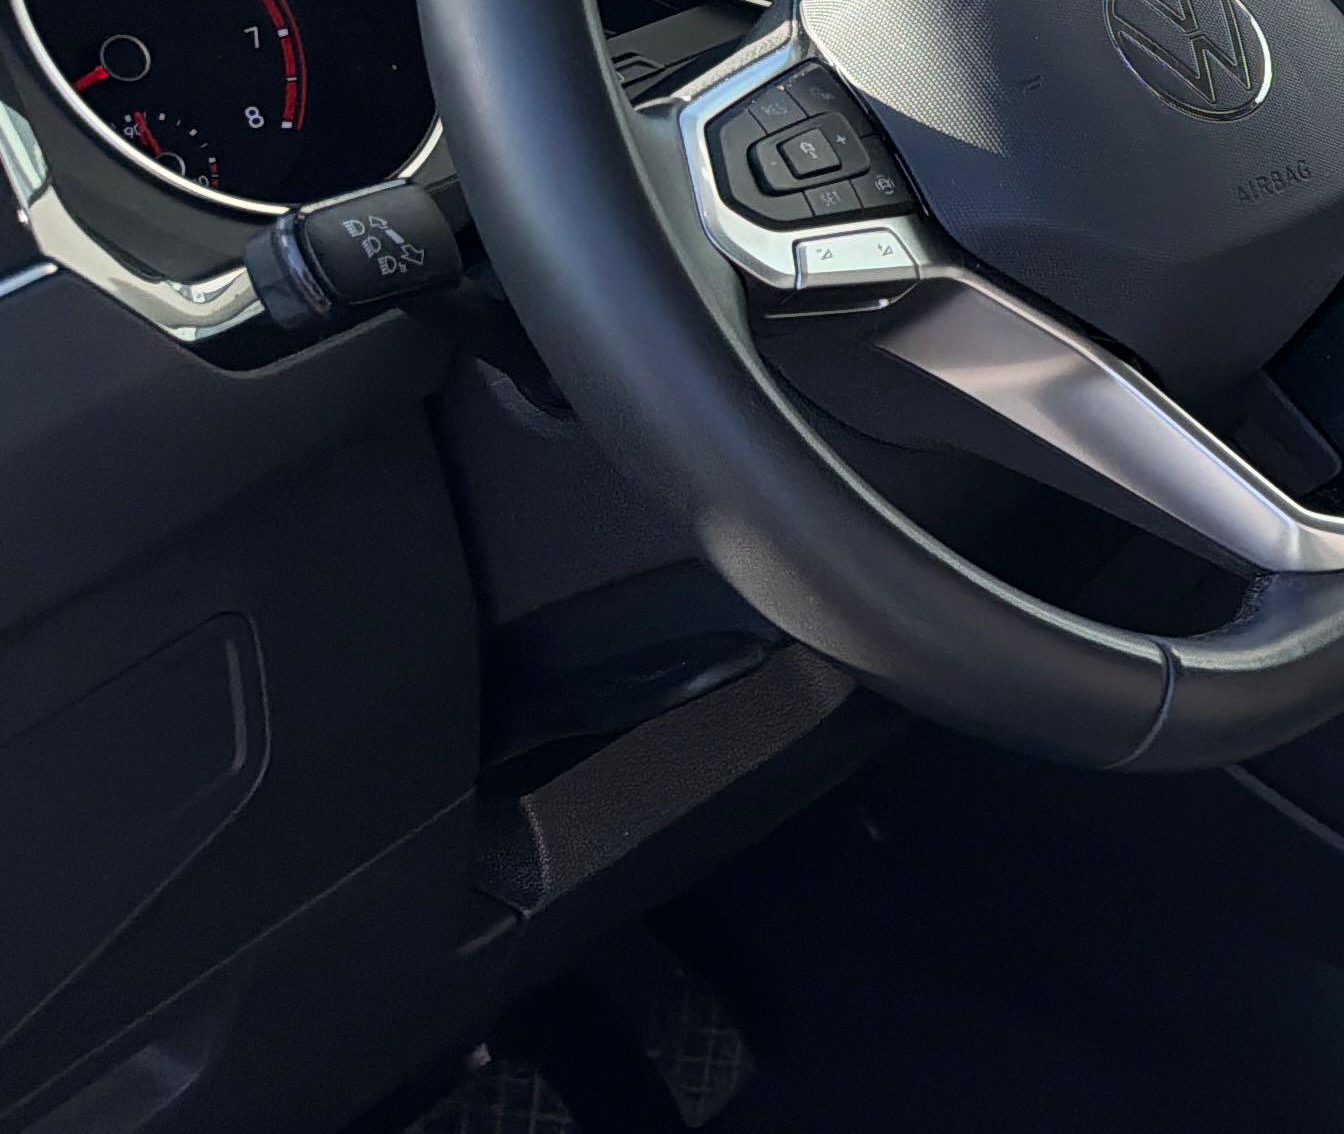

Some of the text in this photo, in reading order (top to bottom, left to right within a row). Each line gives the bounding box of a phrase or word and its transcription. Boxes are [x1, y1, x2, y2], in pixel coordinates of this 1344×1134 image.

[243, 26, 260, 49] 7
[244, 106, 265, 129] 8
[1235, 159, 1312, 202] AIRBAG
